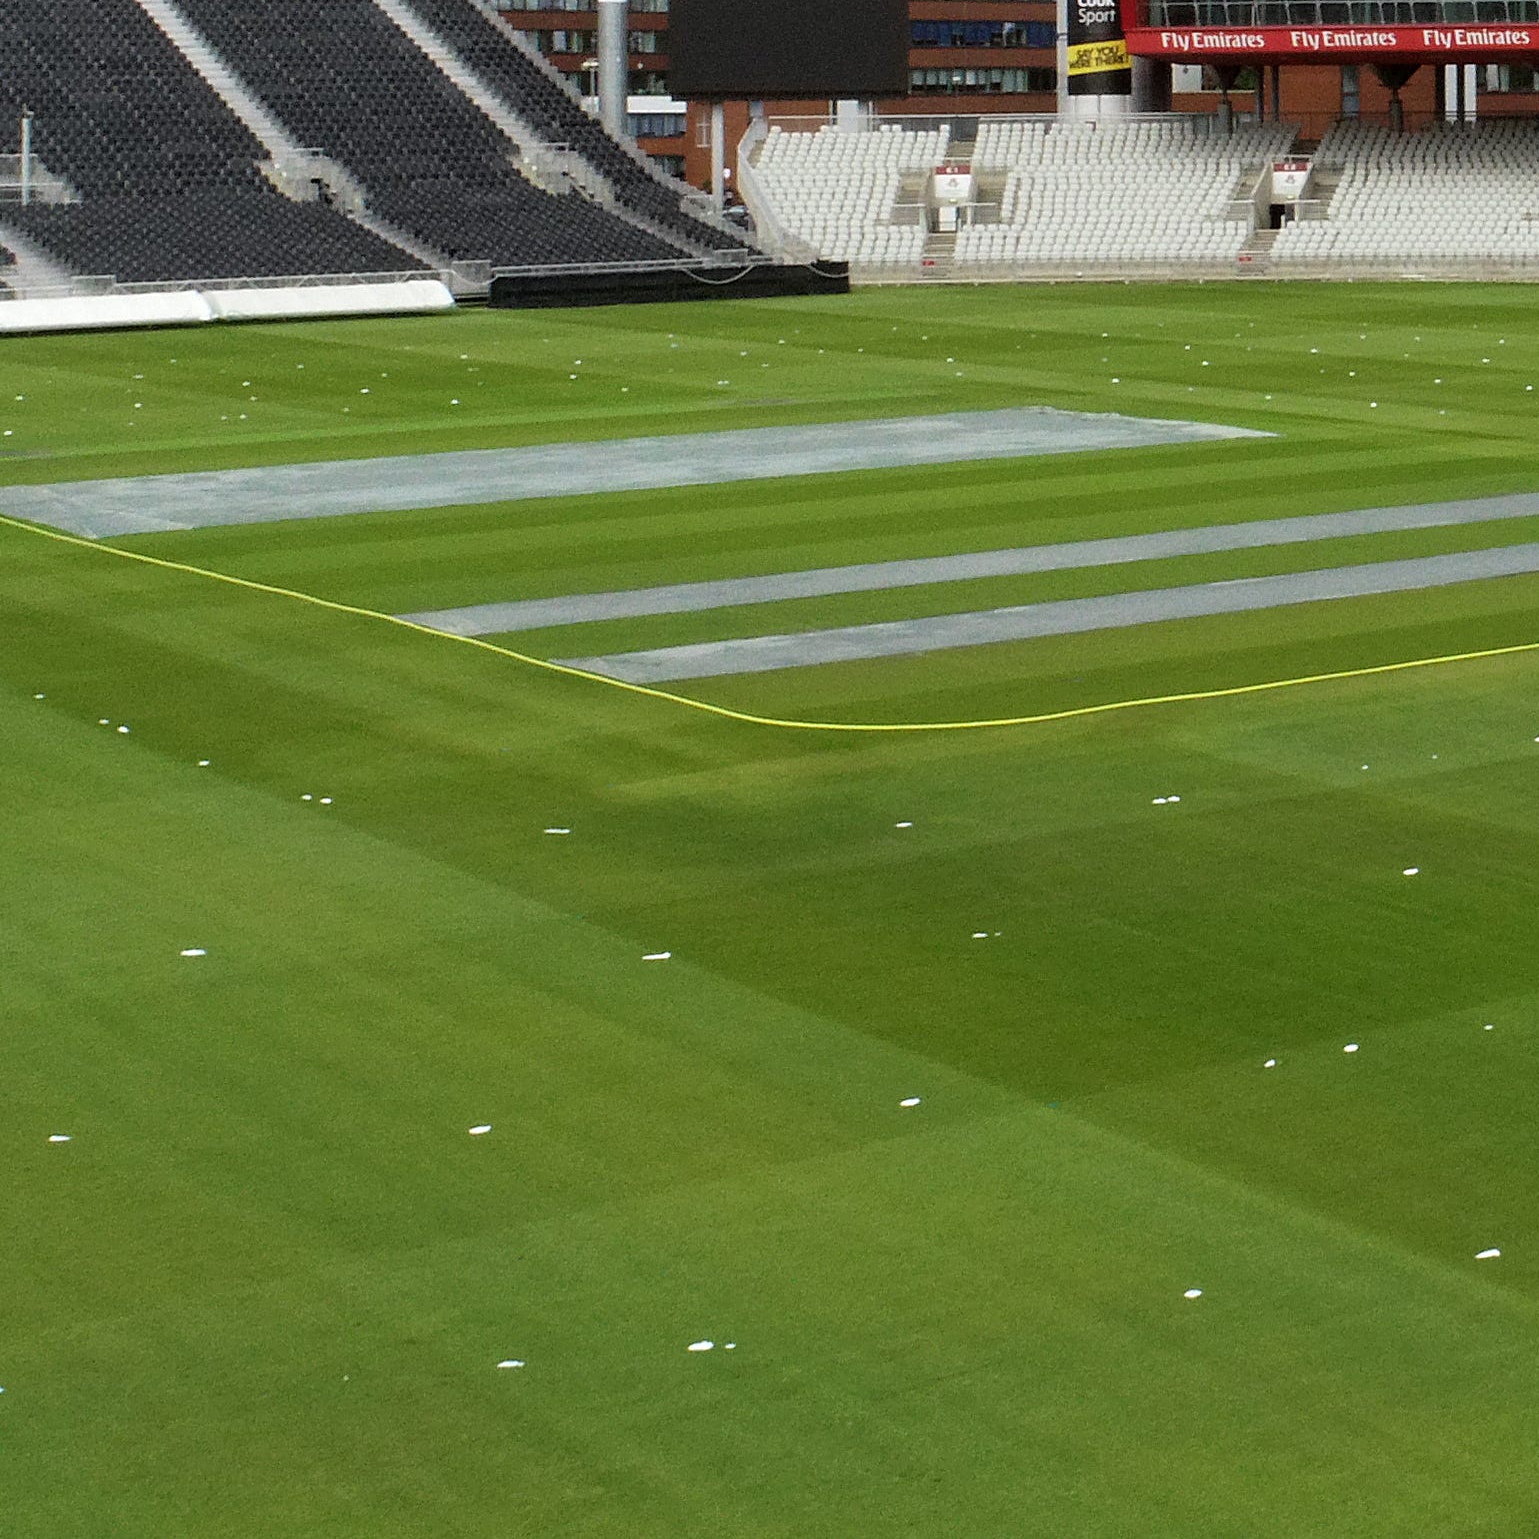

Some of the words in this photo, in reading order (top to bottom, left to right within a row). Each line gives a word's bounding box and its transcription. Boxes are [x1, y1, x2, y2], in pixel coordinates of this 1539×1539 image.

[1078, 8, 1115, 26] Sport
[1161, 32, 1189, 51] Fly
[1192, 31, 1265, 49] Emirates
[1291, 31, 1319, 50] Fly
[1322, 29, 1396, 47] Emirates
[1423, 29, 1451, 48] Fly
[1454, 28, 1530, 46] Emirates
